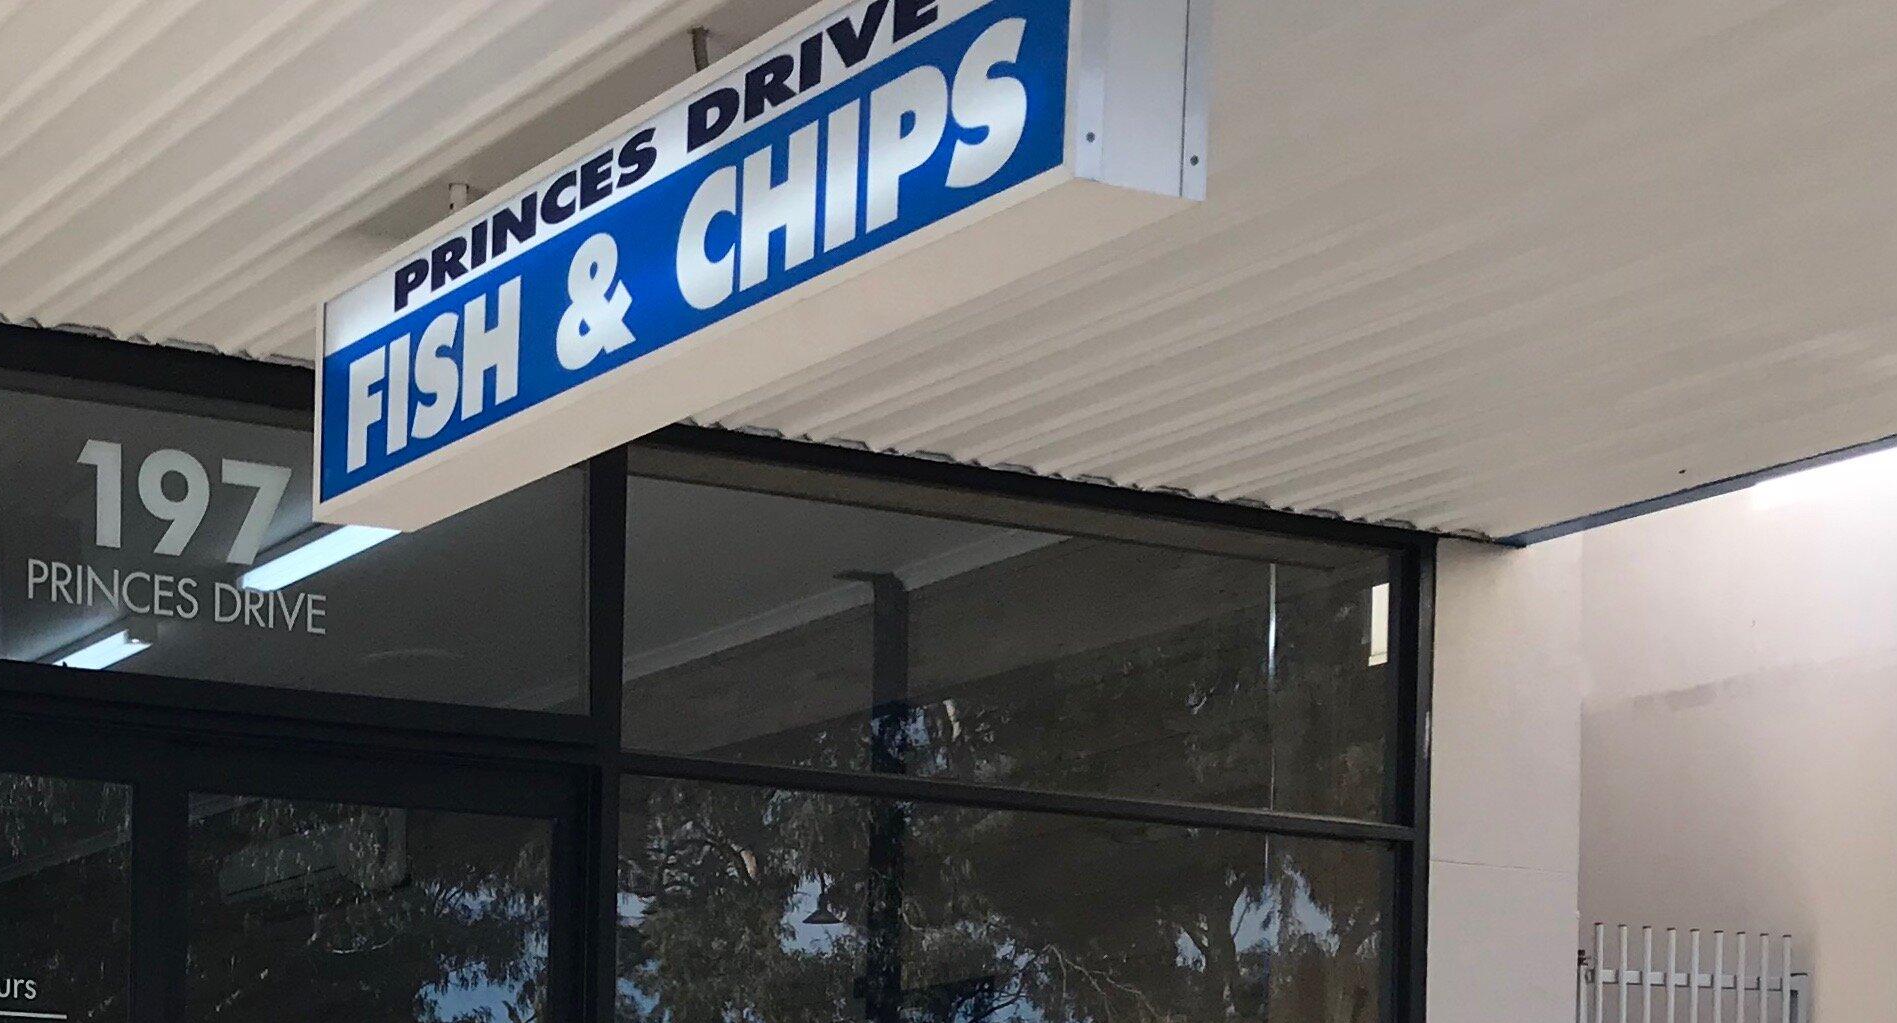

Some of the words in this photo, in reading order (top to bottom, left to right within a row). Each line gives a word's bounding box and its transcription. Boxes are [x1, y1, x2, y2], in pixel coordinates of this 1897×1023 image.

[346, 275, 522, 475] FISH
[556, 231, 635, 371] &
[675, 17, 1028, 311] CHIPS
[394, 126, 657, 311] PRINCES
[686, 0, 940, 153] DRIVE
[26, 557, 199, 620] PRINCES
[214, 582, 327, 636] DRIVE
[76, 438, 293, 565] 197
